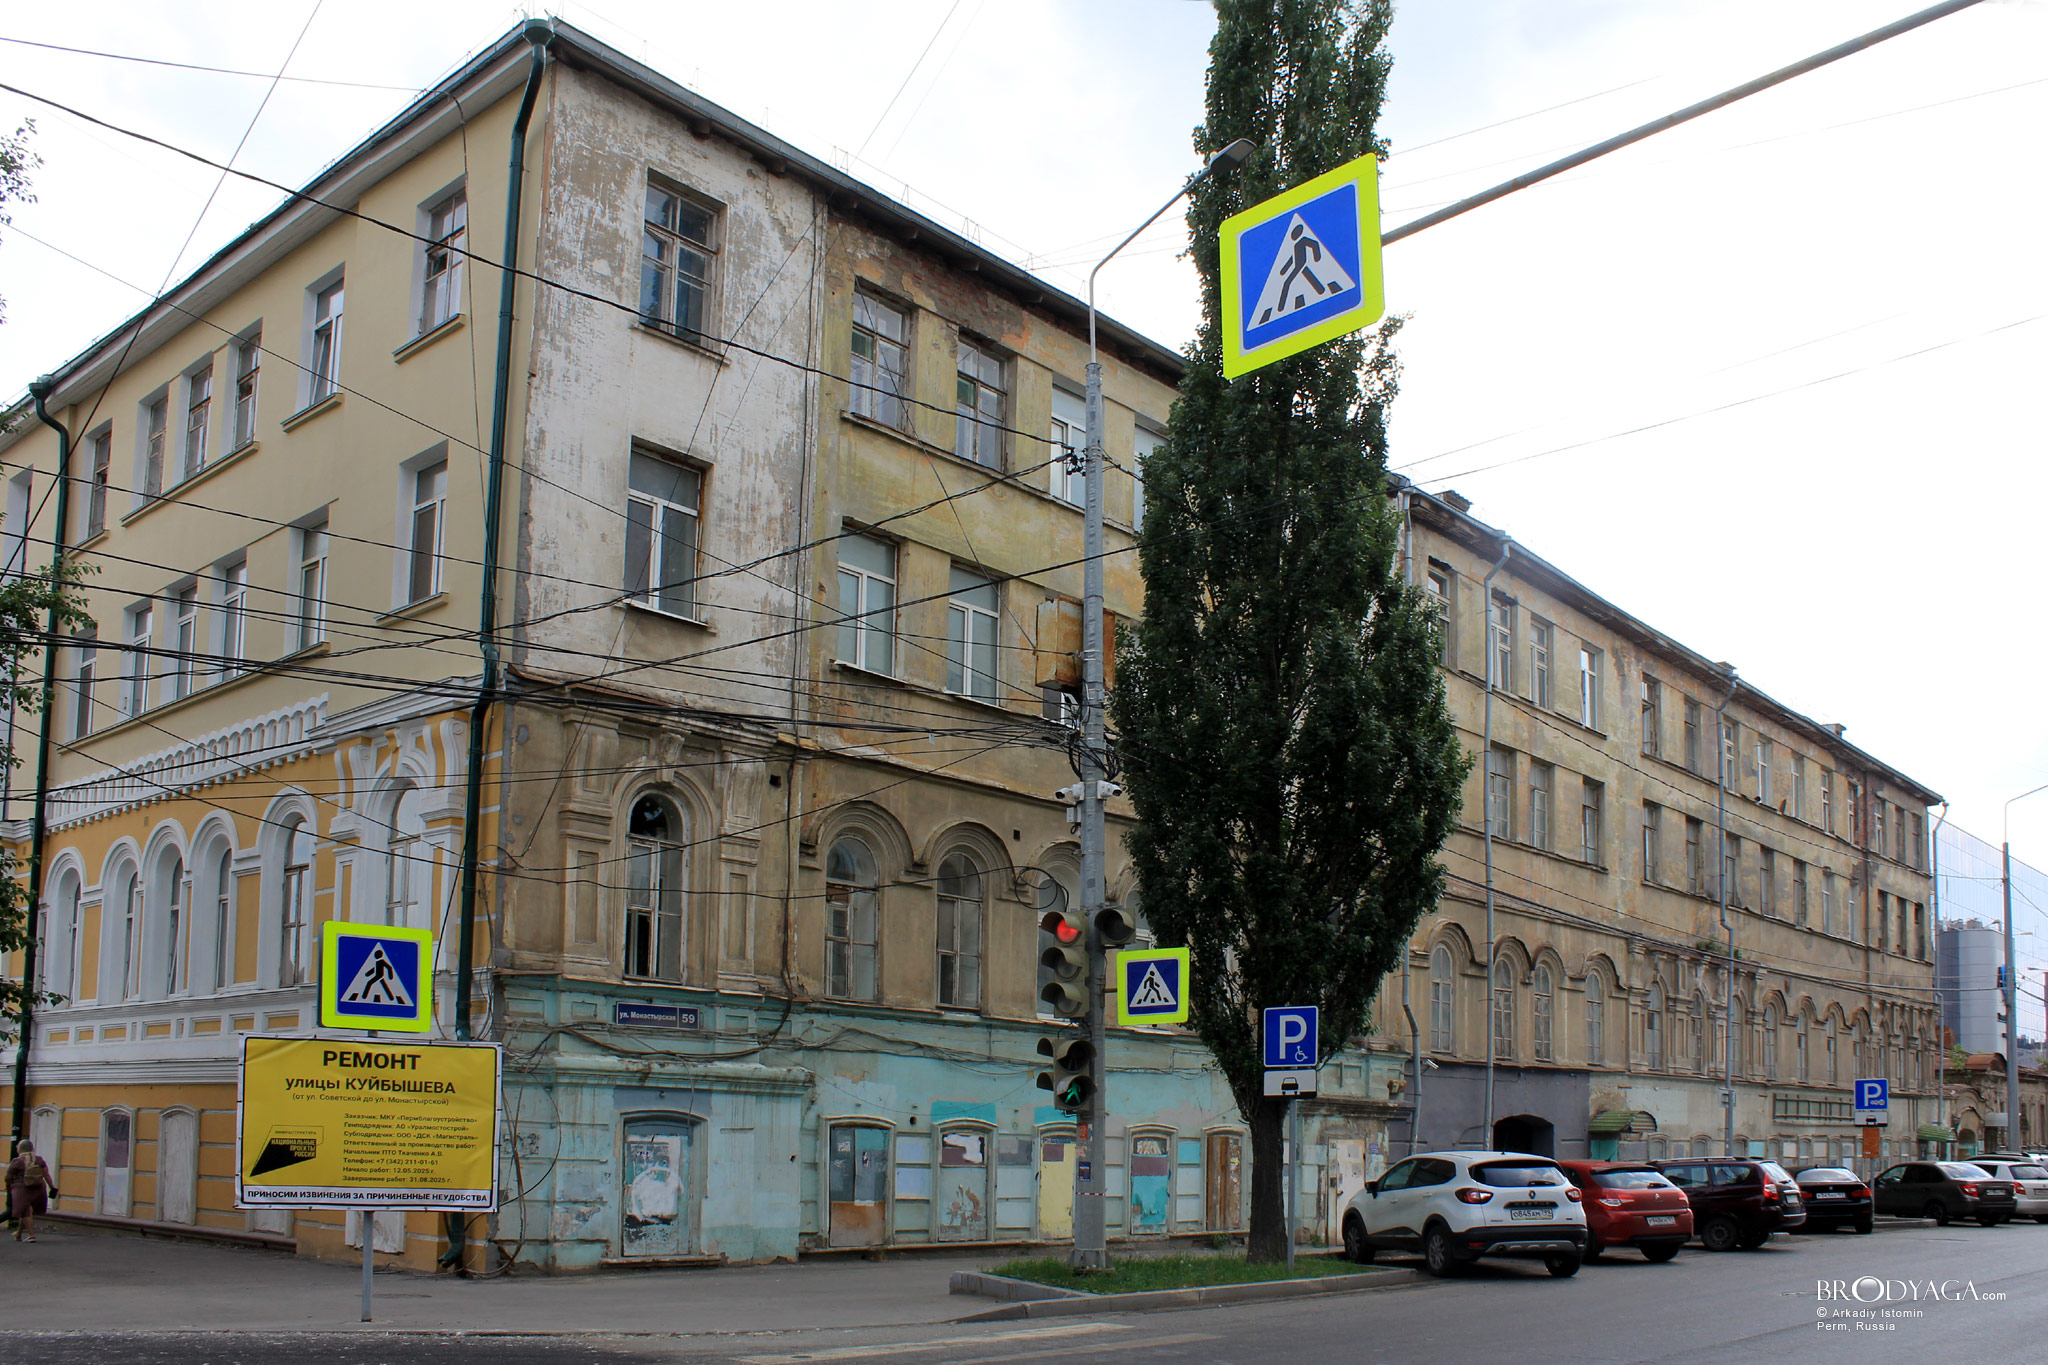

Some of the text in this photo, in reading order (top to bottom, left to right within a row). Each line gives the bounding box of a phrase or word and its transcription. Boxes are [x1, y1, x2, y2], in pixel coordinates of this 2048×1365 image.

[681, 1014, 695, 1023] 59
[1279, 1014, 1307, 1060] P
[323, 1050, 422, 1070] РЕМОНТ
[285, 1076, 456, 1094] улицы КУЙБЫШЕВА
[306, 1094, 317, 1102] ул.
[319, 1093, 362, 1102] Советской
[387, 1096, 449, 1106] Монастырской)
[1864, 1083, 1882, 1107] P
[344, 1112, 379, 1120] Заказчик:
[343, 1139, 398, 1147] Ответственный
[408, 1141, 455, 1149] производство
[343, 1157, 375, 1165] Телефон:
[386, 1158, 404, 1166] (342)
[405, 1158, 438, 1166] 211-01-61
[342, 1175, 385, 1183] Завершение
[247, 1190, 298, 1198] ПРИНОСИМ
[300, 1191, 351, 1199] ИЗВИНЕНИЯ
[353, 1192, 365, 1200] ЗА
[432, 1194, 488, 1202] НЕУДОБСТВА
